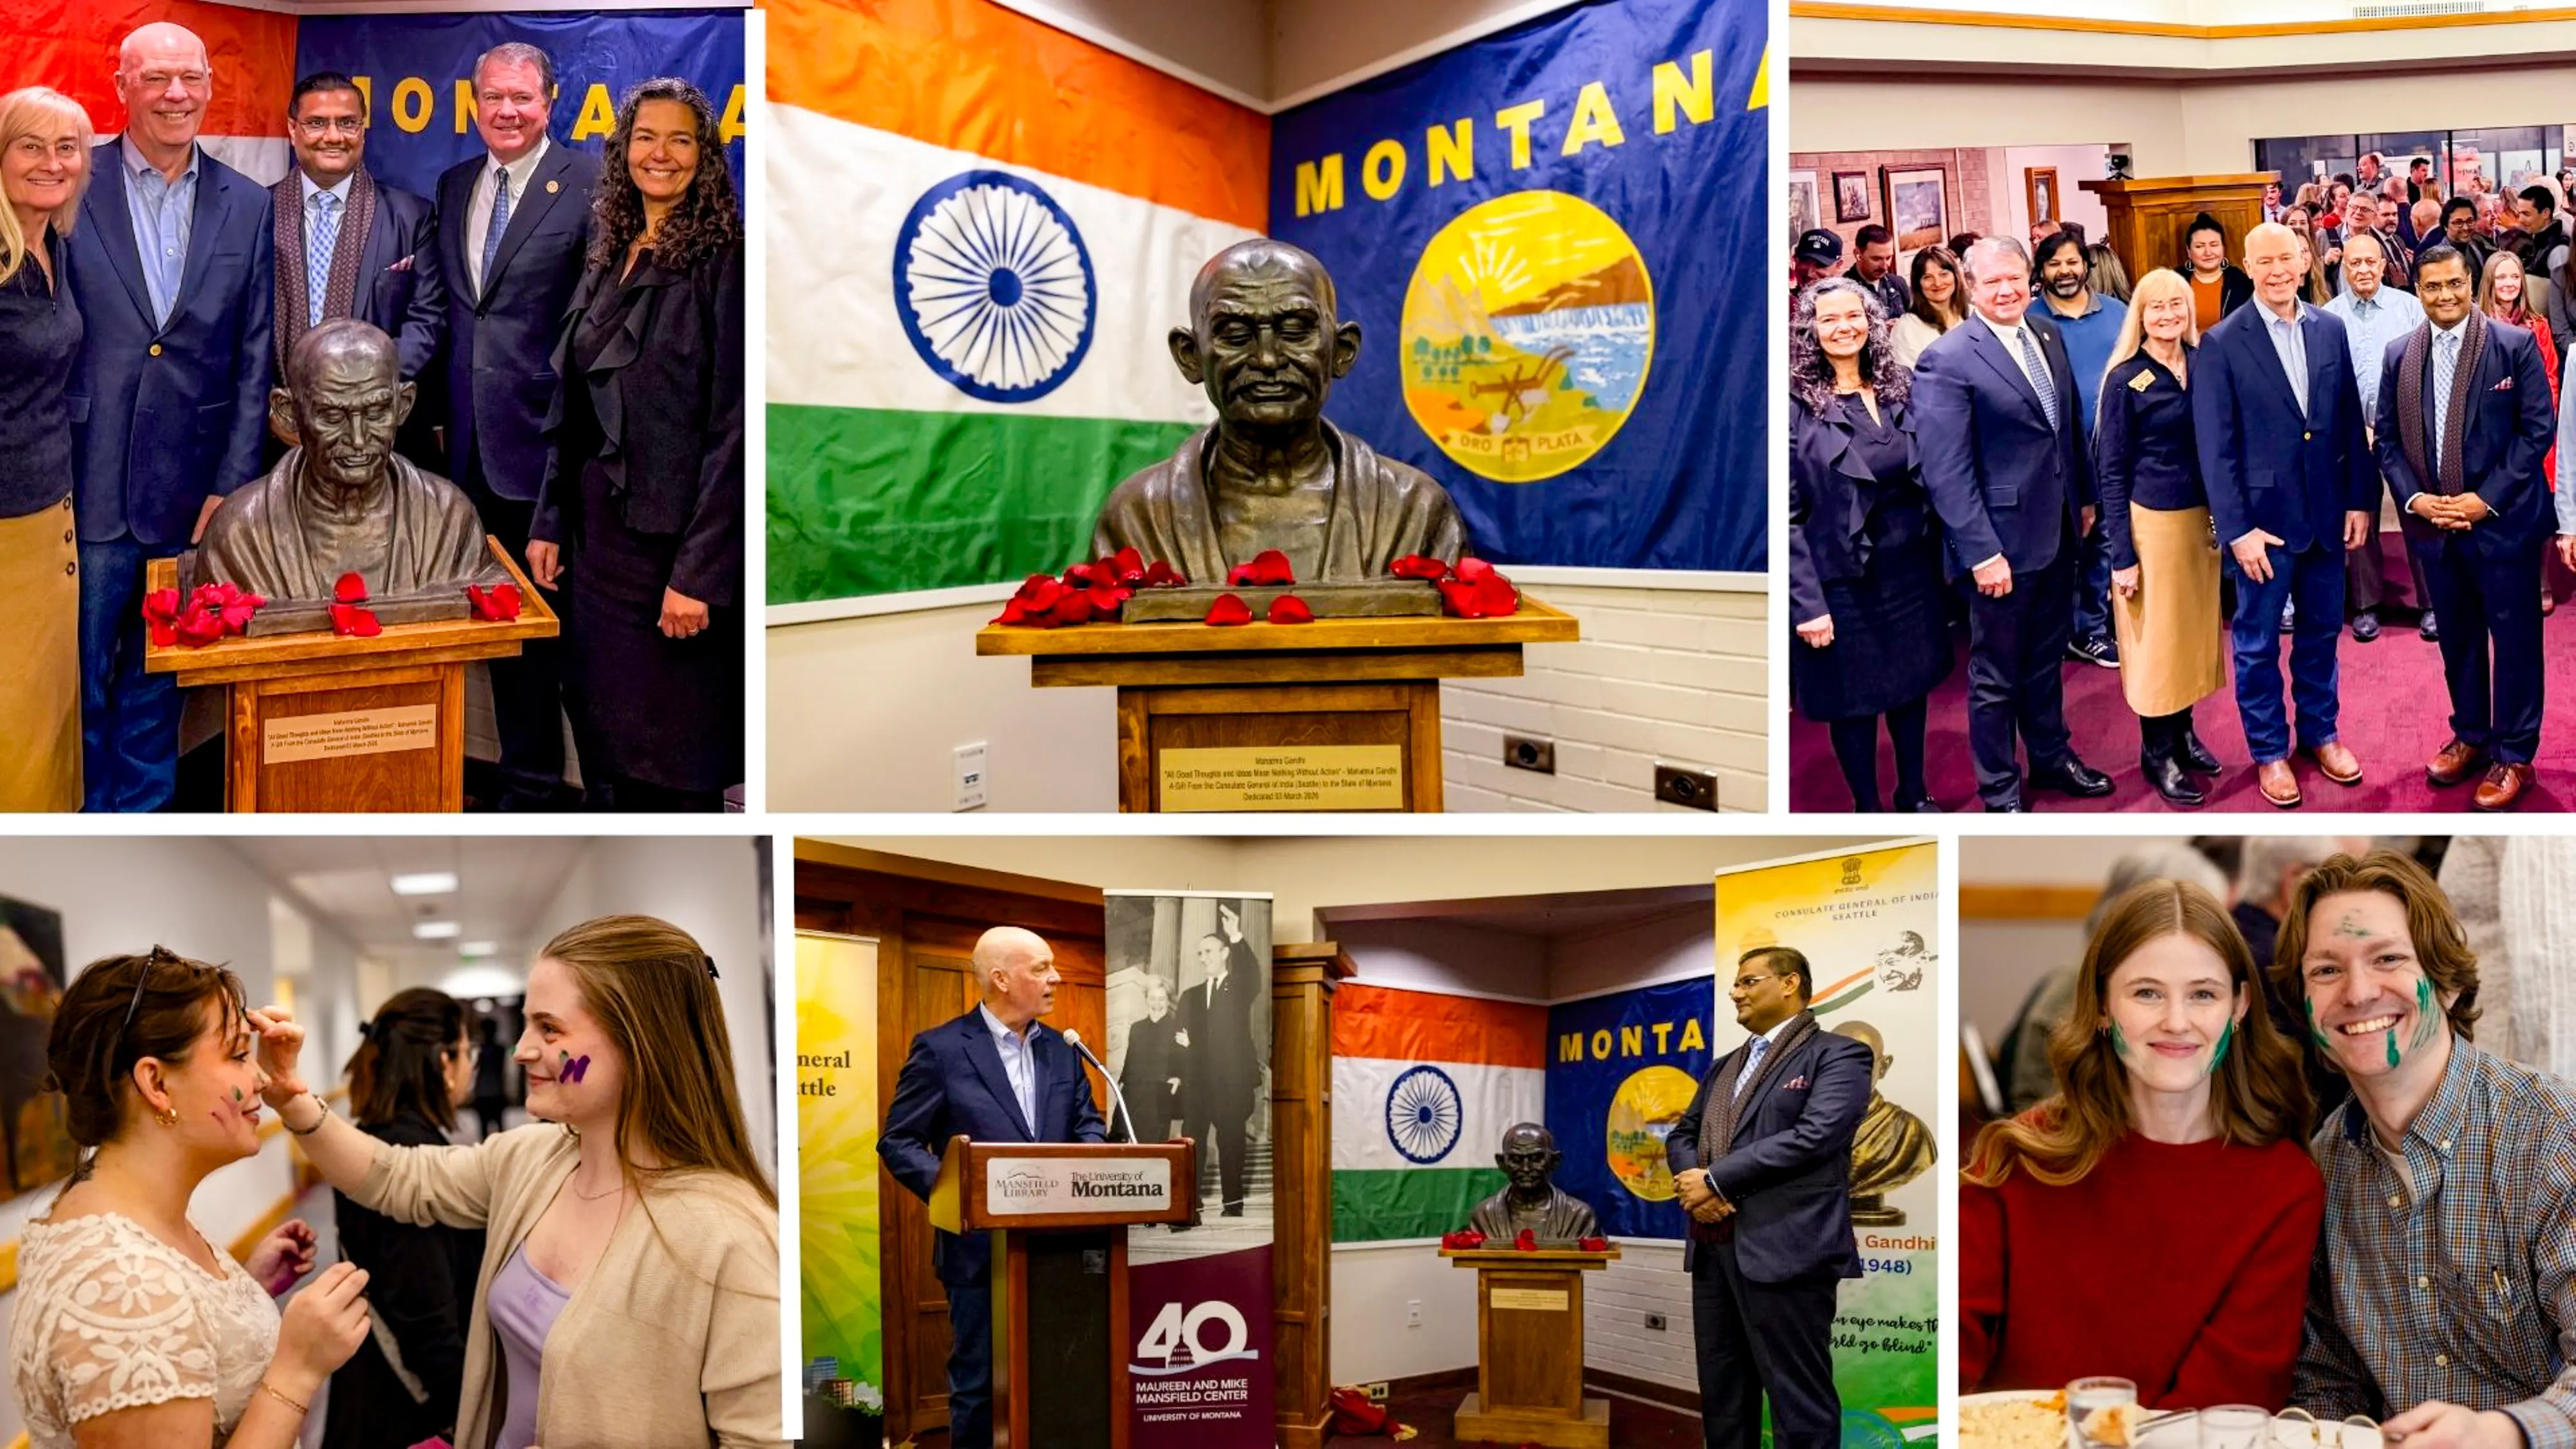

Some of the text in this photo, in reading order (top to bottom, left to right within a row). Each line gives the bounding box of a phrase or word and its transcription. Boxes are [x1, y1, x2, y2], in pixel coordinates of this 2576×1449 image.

[1461, 432, 1582, 452] ORO PLATA
[1775, 904, 1834, 919] CONSULATE
[1839, 898, 1887, 910] GENERAL
[1892, 895, 1906, 904] OF
[1832, 910, 1877, 921] SEATTLE
[797, 1050, 851, 1068] neral
[797, 1077, 836, 1096] ttle
[996, 1179, 1058, 1189] MANSFIELD
[1072, 1171, 1145, 1183] The University of
[1003, 1189, 1048, 1198] LIBRARY
[1072, 1181, 1163, 1198] Montana
[1866, 1235, 1936, 1250] Gandhi
[1850, 1316, 1875, 1332] eye
[1877, 1316, 1924, 1332] makes
[1137, 1300, 1247, 1370] 40
[1859, 1340, 1879, 1354] go
[1136, 1378, 1248, 1392] MAUREEN AND MIKE
[1136, 1390, 1247, 1404] MANSFIELD CENTER
[1144, 1413, 1187, 1422] UNIVERSITY
[1202, 1411, 1242, 1419] MONTANA
